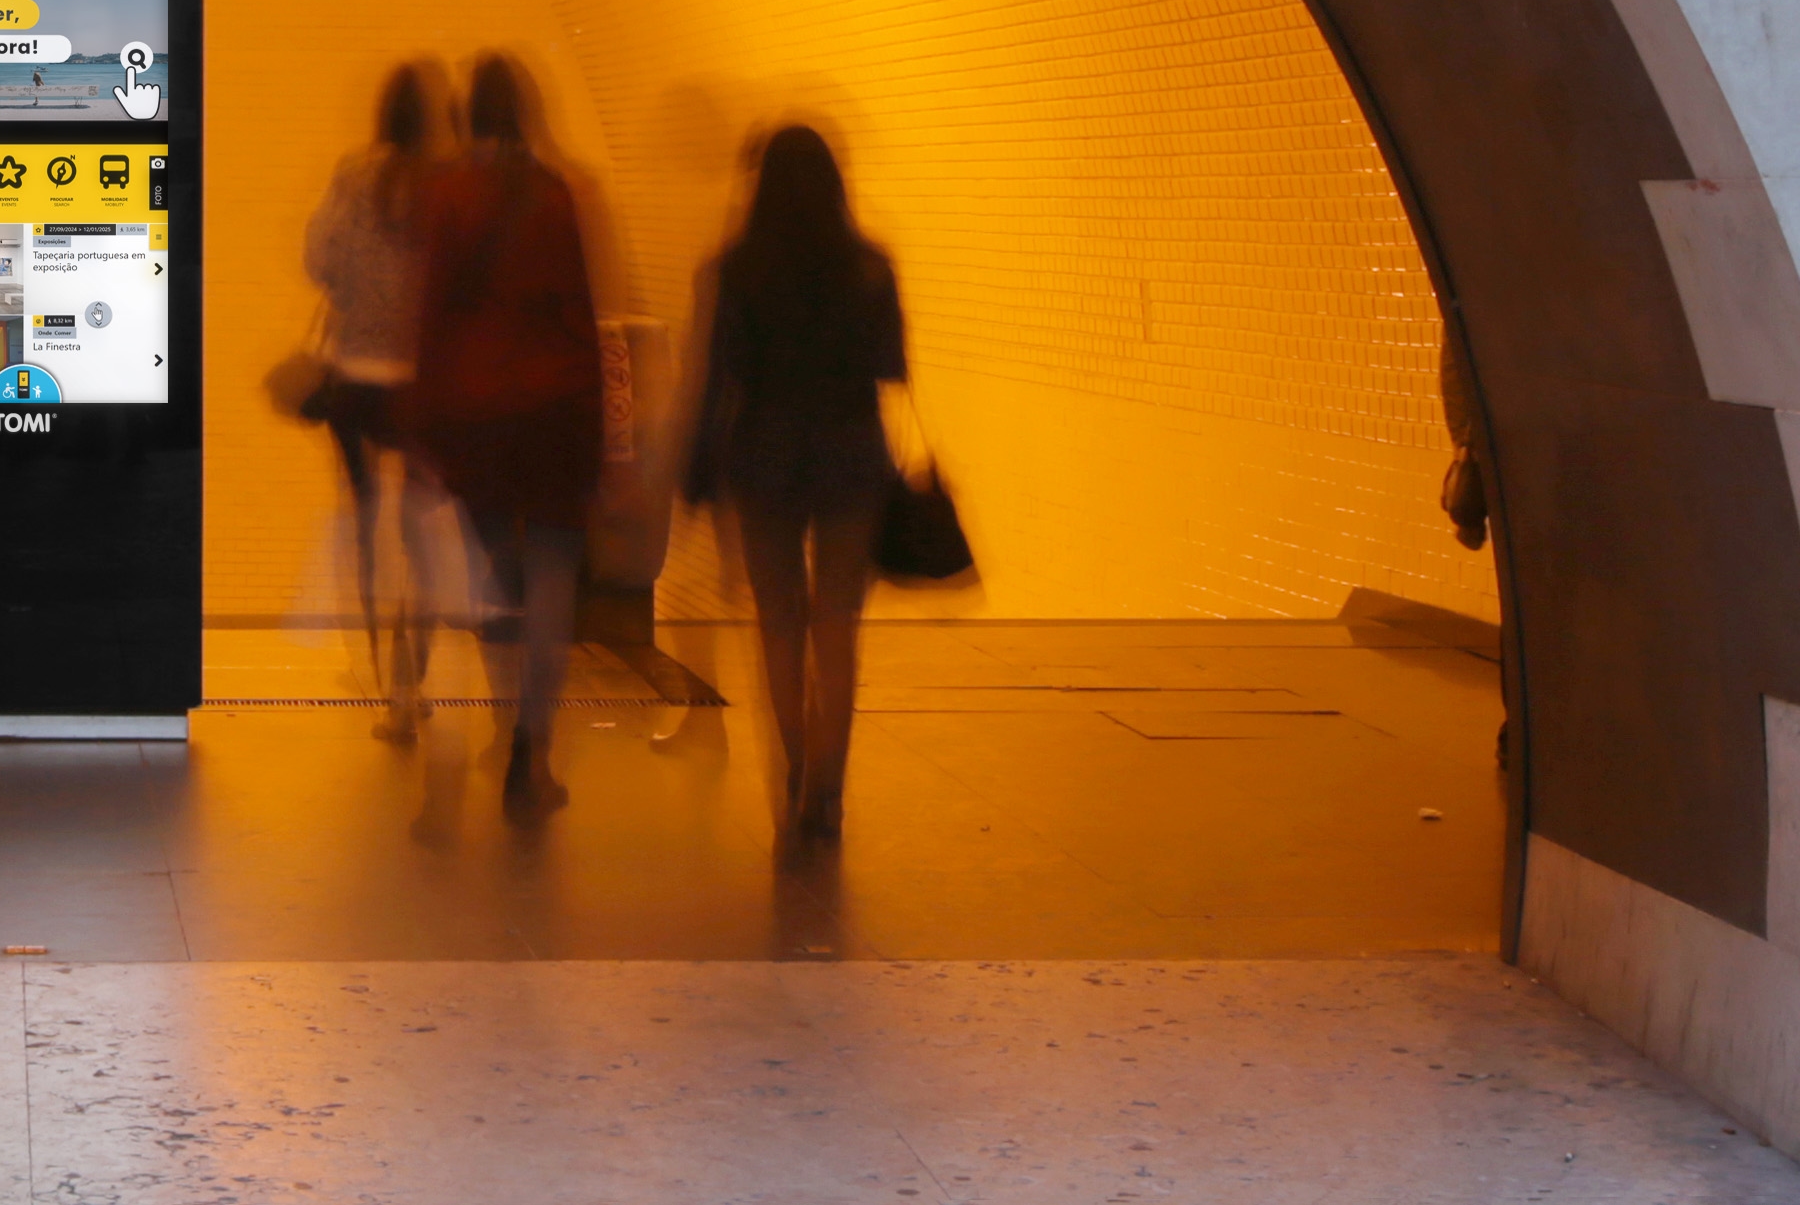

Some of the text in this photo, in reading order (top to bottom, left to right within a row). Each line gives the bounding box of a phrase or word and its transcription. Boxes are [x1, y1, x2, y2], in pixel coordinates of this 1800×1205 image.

[33, 251, 75, 261] Tapeçaria
[78, 252, 129, 261] portuguesa
[33, 264, 78, 273] exposição
[33, 342, 81, 351] La Finestra
